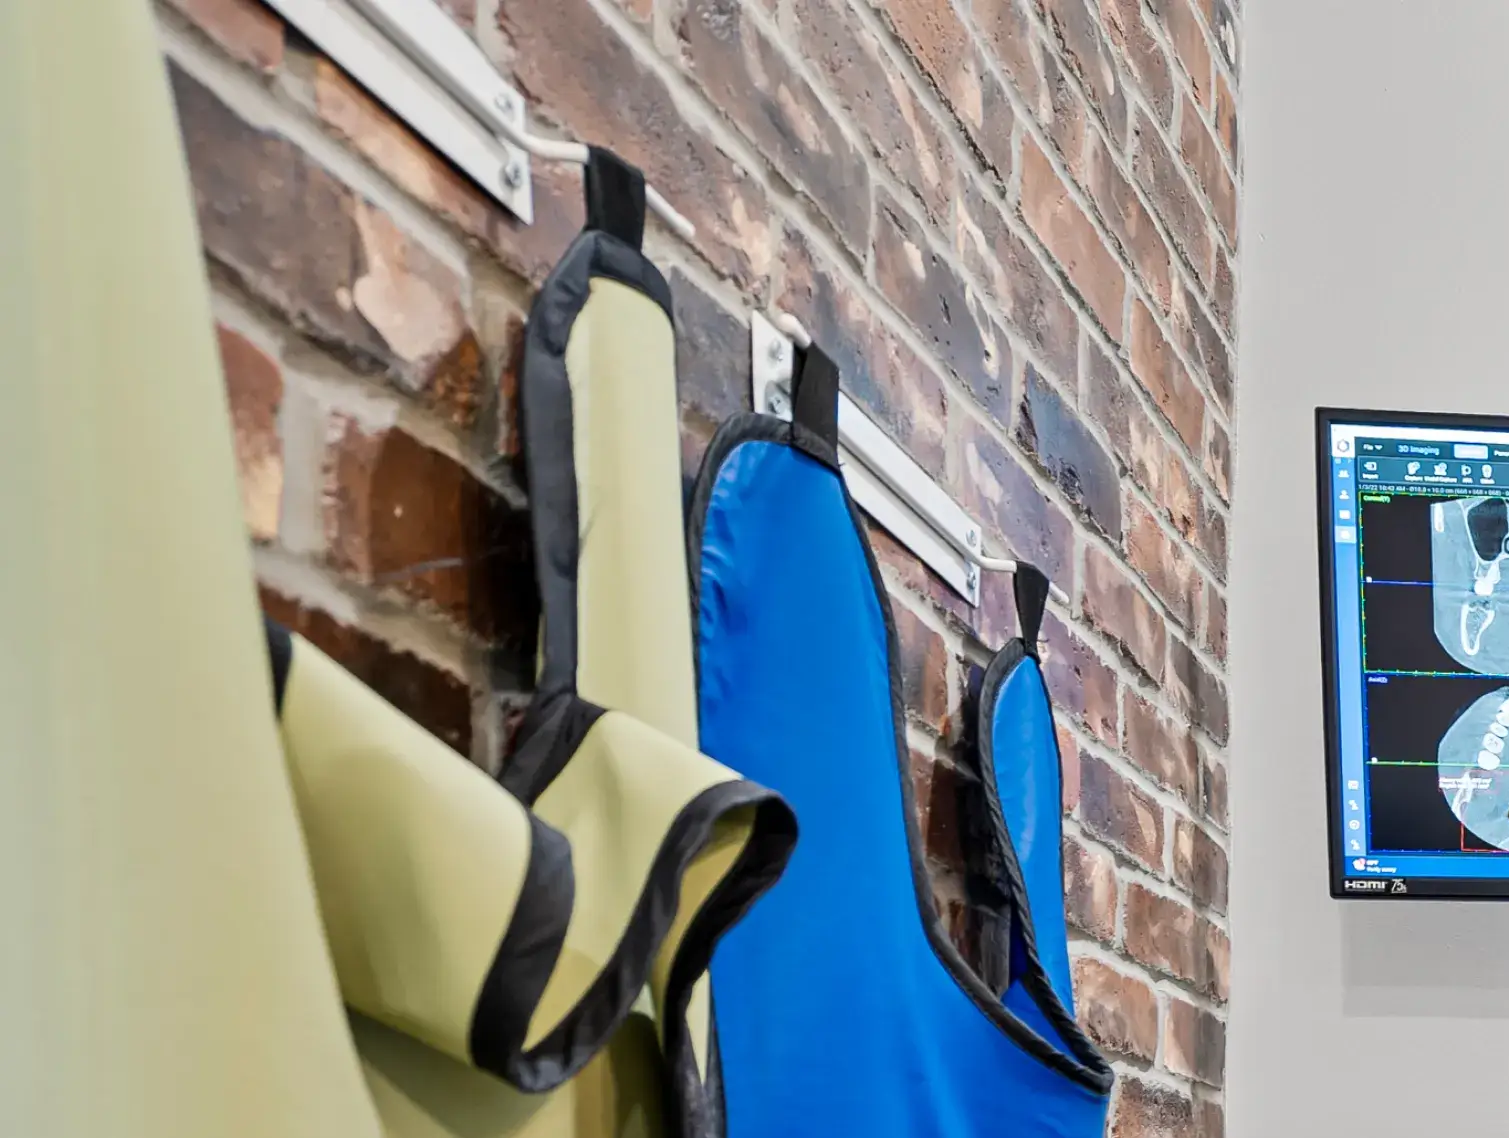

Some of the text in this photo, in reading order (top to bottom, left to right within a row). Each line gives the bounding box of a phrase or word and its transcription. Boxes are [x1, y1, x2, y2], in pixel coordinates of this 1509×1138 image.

[1398, 444, 1440, 456] 3D Imaging
[1344, 880, 1386, 890] HDMI
